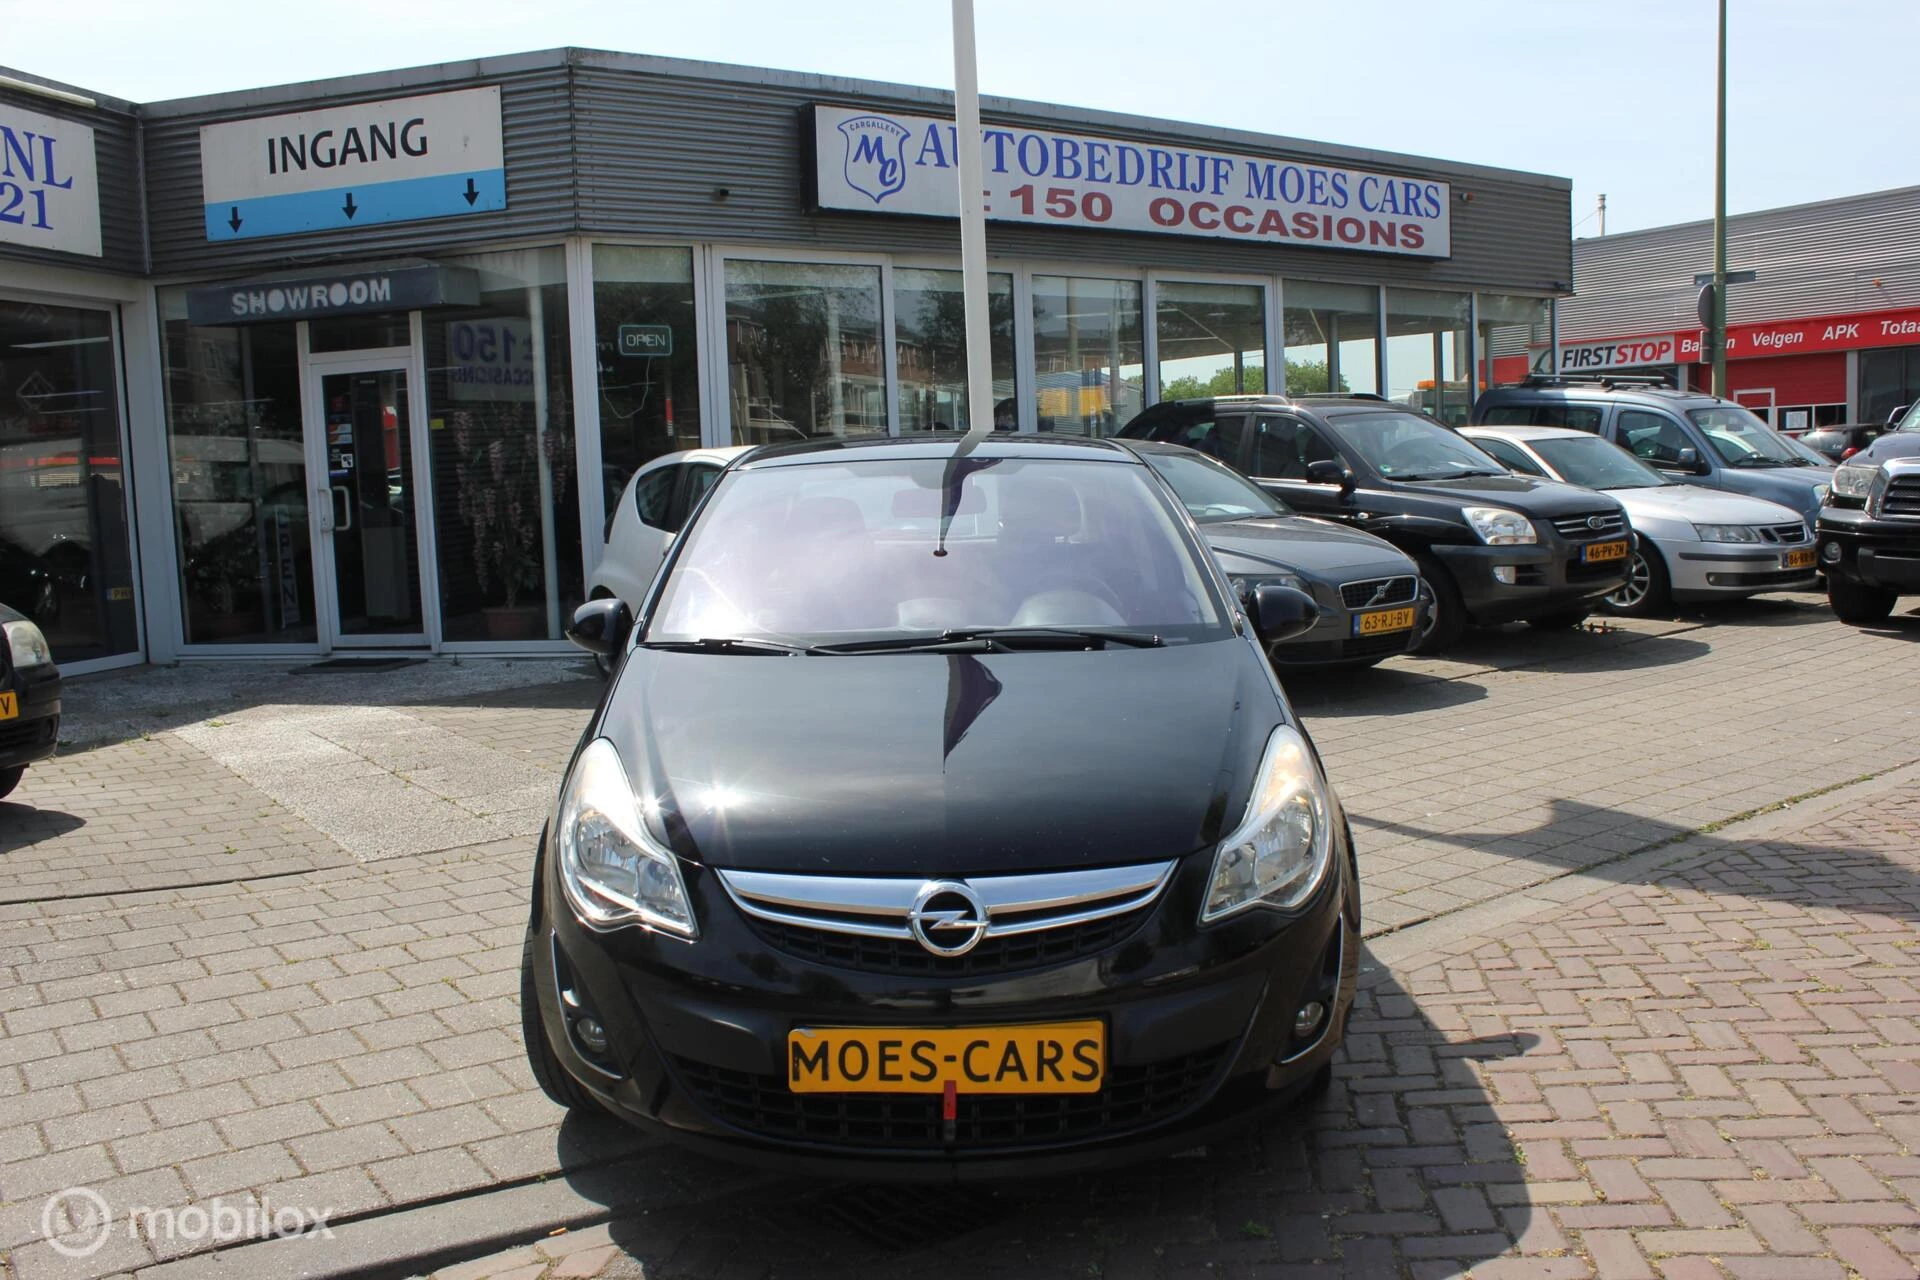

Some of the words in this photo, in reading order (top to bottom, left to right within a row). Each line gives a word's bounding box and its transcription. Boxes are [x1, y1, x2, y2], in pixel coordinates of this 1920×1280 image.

[268, 118, 428, 175] INGANG
[849, 120, 901, 137] CARGALLERY
[1245, 161, 1349, 209] MOES
[1358, 176, 1441, 220] CARS
[1010, 184, 1113, 222] 150
[1149, 197, 1425, 249] OCCASIONS
[231, 277, 391, 316] SHOWROOM
[626, 334, 666, 347] OPEN
[1752, 331, 1804, 348] Velgen
[1822, 323, 1860, 341] APK
[1364, 610, 1410, 630] 63-RJ-BV
[791, 1039, 1100, 1084] MOES-CARS
